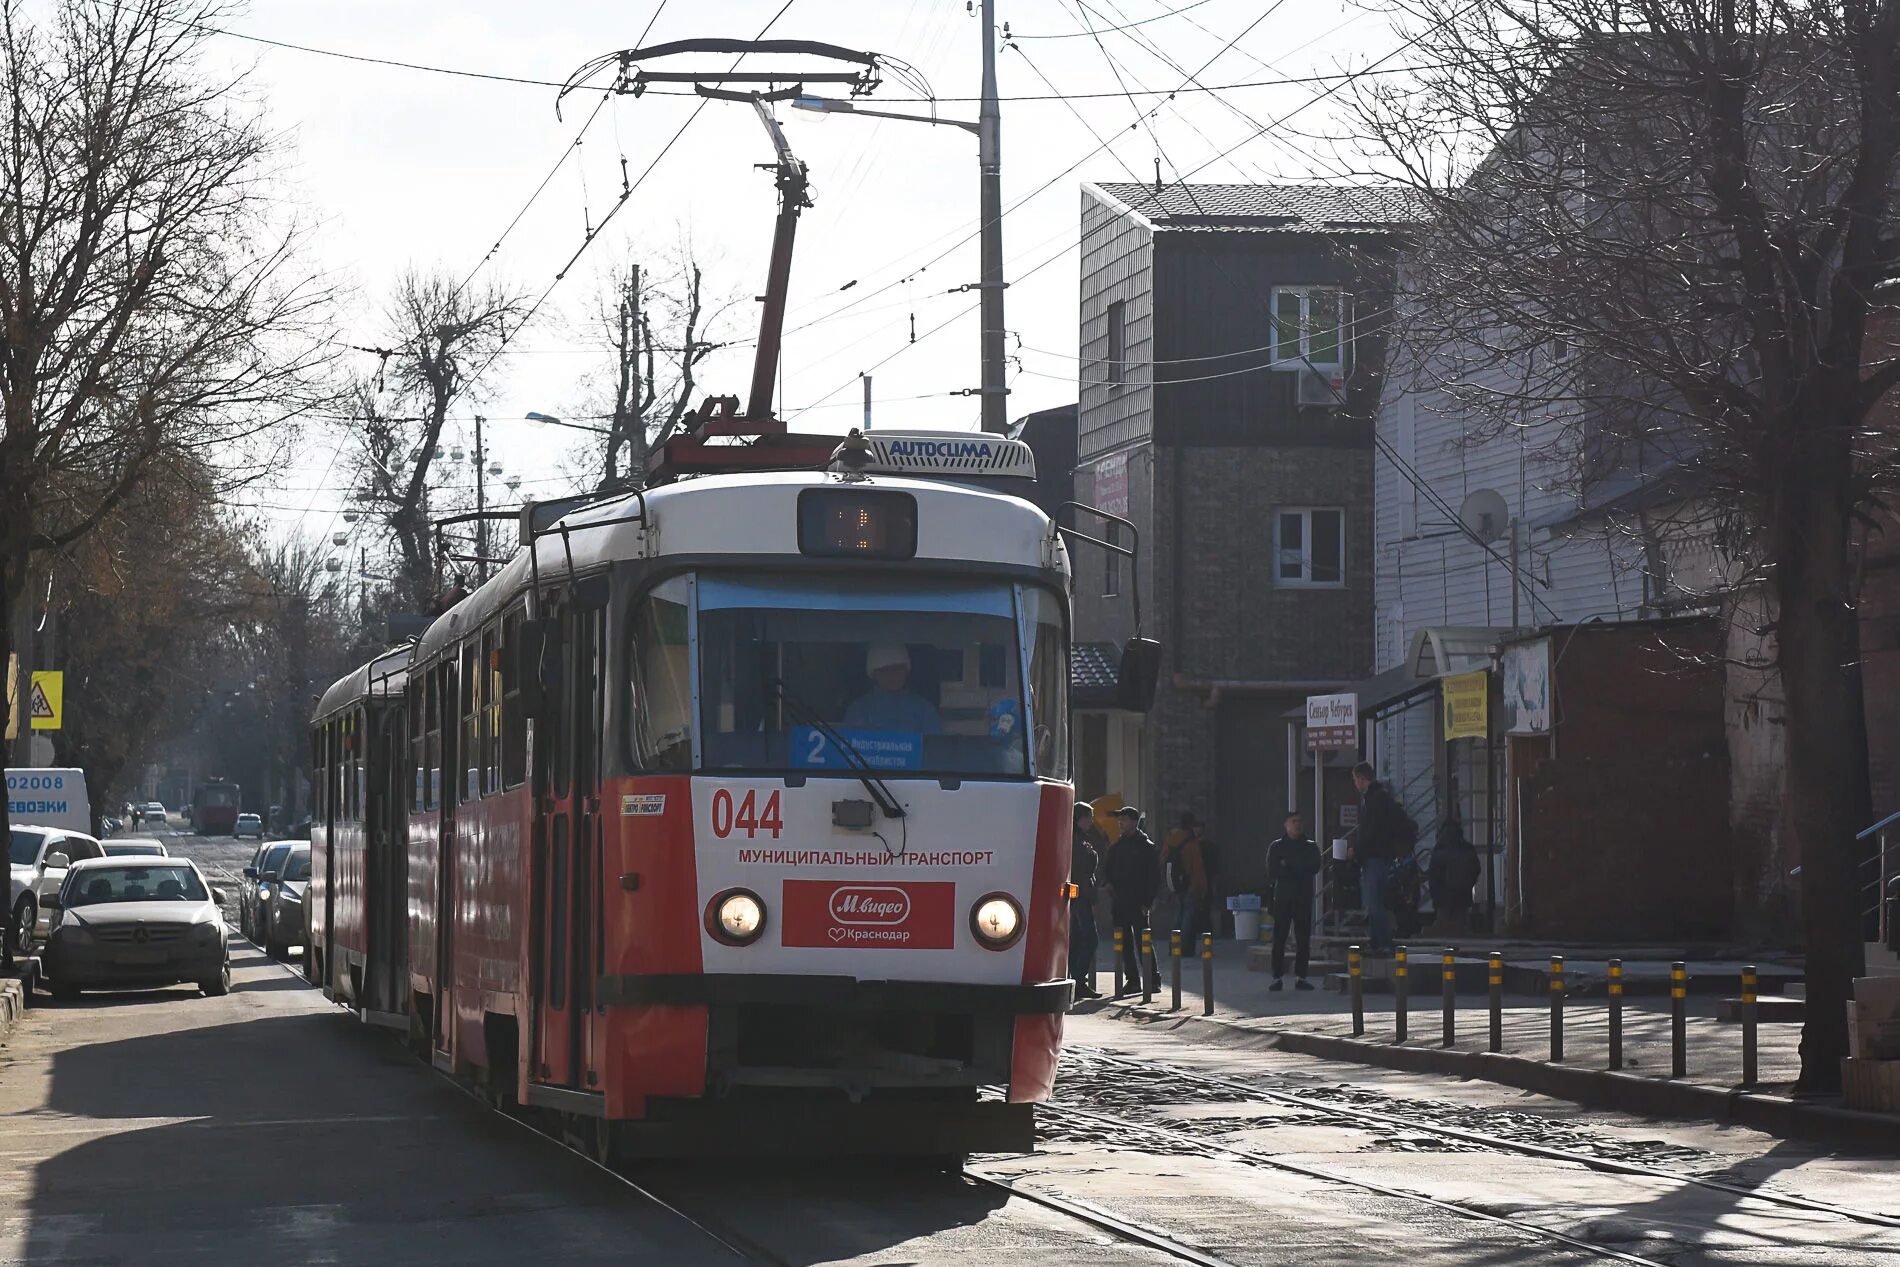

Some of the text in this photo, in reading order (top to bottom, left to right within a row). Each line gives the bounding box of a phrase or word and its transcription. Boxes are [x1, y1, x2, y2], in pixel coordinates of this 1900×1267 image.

[889, 440, 993, 459] AUTOCLIMA
[807, 730, 826, 764] 2
[8, 776, 63, 790] 02008
[8, 801, 67, 813] ЕВОЗКИ
[712, 788, 783, 839] 044
[738, 849, 993, 867] МУНИЦИПАЛЬНЫЙ ТРАНСПОРТ
[837, 895, 903, 917] М.видео
[847, 928, 910, 943] Краснодар
